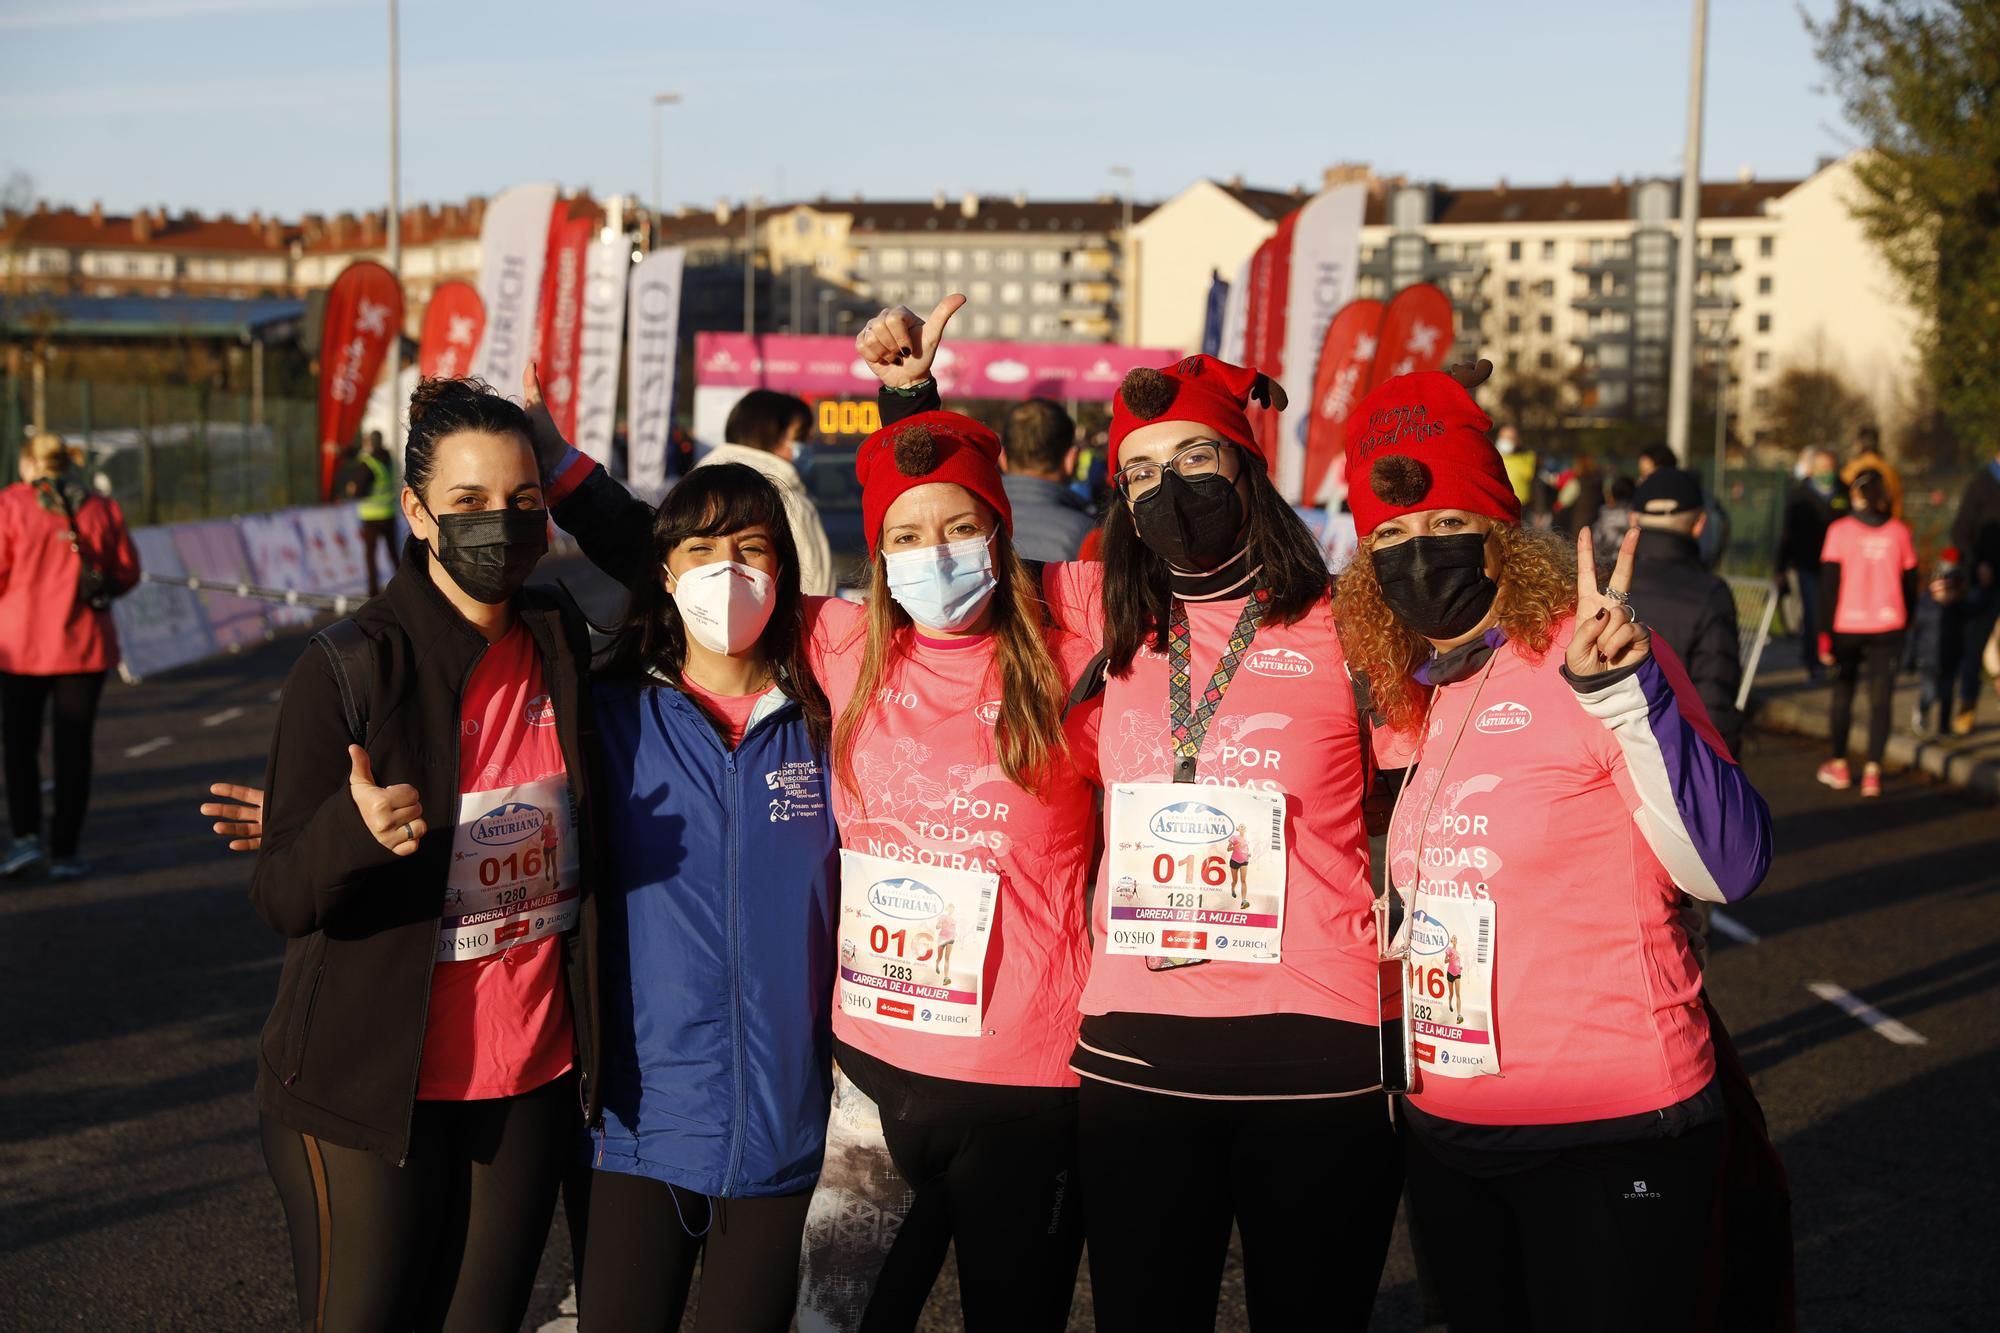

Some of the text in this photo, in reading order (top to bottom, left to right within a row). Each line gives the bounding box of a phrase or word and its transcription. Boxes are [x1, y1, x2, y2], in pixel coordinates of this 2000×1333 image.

[486, 254, 525, 380] ZURICH
[637, 281, 671, 472] OYSHO
[1249, 660, 1308, 673] ASTURIANA
[1478, 714, 1526, 728] ASTURIANA
[782, 760, 815, 768] L'esport
[1222, 746, 1281, 770] POR
[782, 768, 796, 776] per
[952, 797, 1010, 822] POR
[477, 818, 540, 840] ASTURIANA
[1155, 816, 1228, 835] ASTURIANA
[1443, 815, 1489, 835] POR
[915, 820, 1004, 850] TODAS
[868, 838, 999, 874] NOSOTRAS
[1424, 847, 1488, 868] TODAS
[479, 848, 542, 887] 016
[1152, 853, 1227, 886] 016
[496, 886, 527, 906] 1280
[872, 888, 938, 914] ASTURIANA
[1167, 892, 1204, 908] 1281
[461, 893, 559, 925] CARRERA DE LA MUJER
[1136, 908, 1248, 924] CARRERA DE LA MUJER
[1114, 930, 1155, 945] OYSHO
[1232, 939, 1268, 949] ZURICH
[1410, 929, 1445, 946] STURIANA
[882, 963, 913, 981] 1283
[852, 973, 950, 1000] CARRERA DE LA MUJER
[843, 991, 872, 1009] YSHO
[935, 1013, 968, 1024] ZURICH
[1413, 1004, 1432, 1021] 282
[1416, 1022, 1463, 1040] DE LA MUJER
[1452, 1055, 1483, 1064] ZURICH
